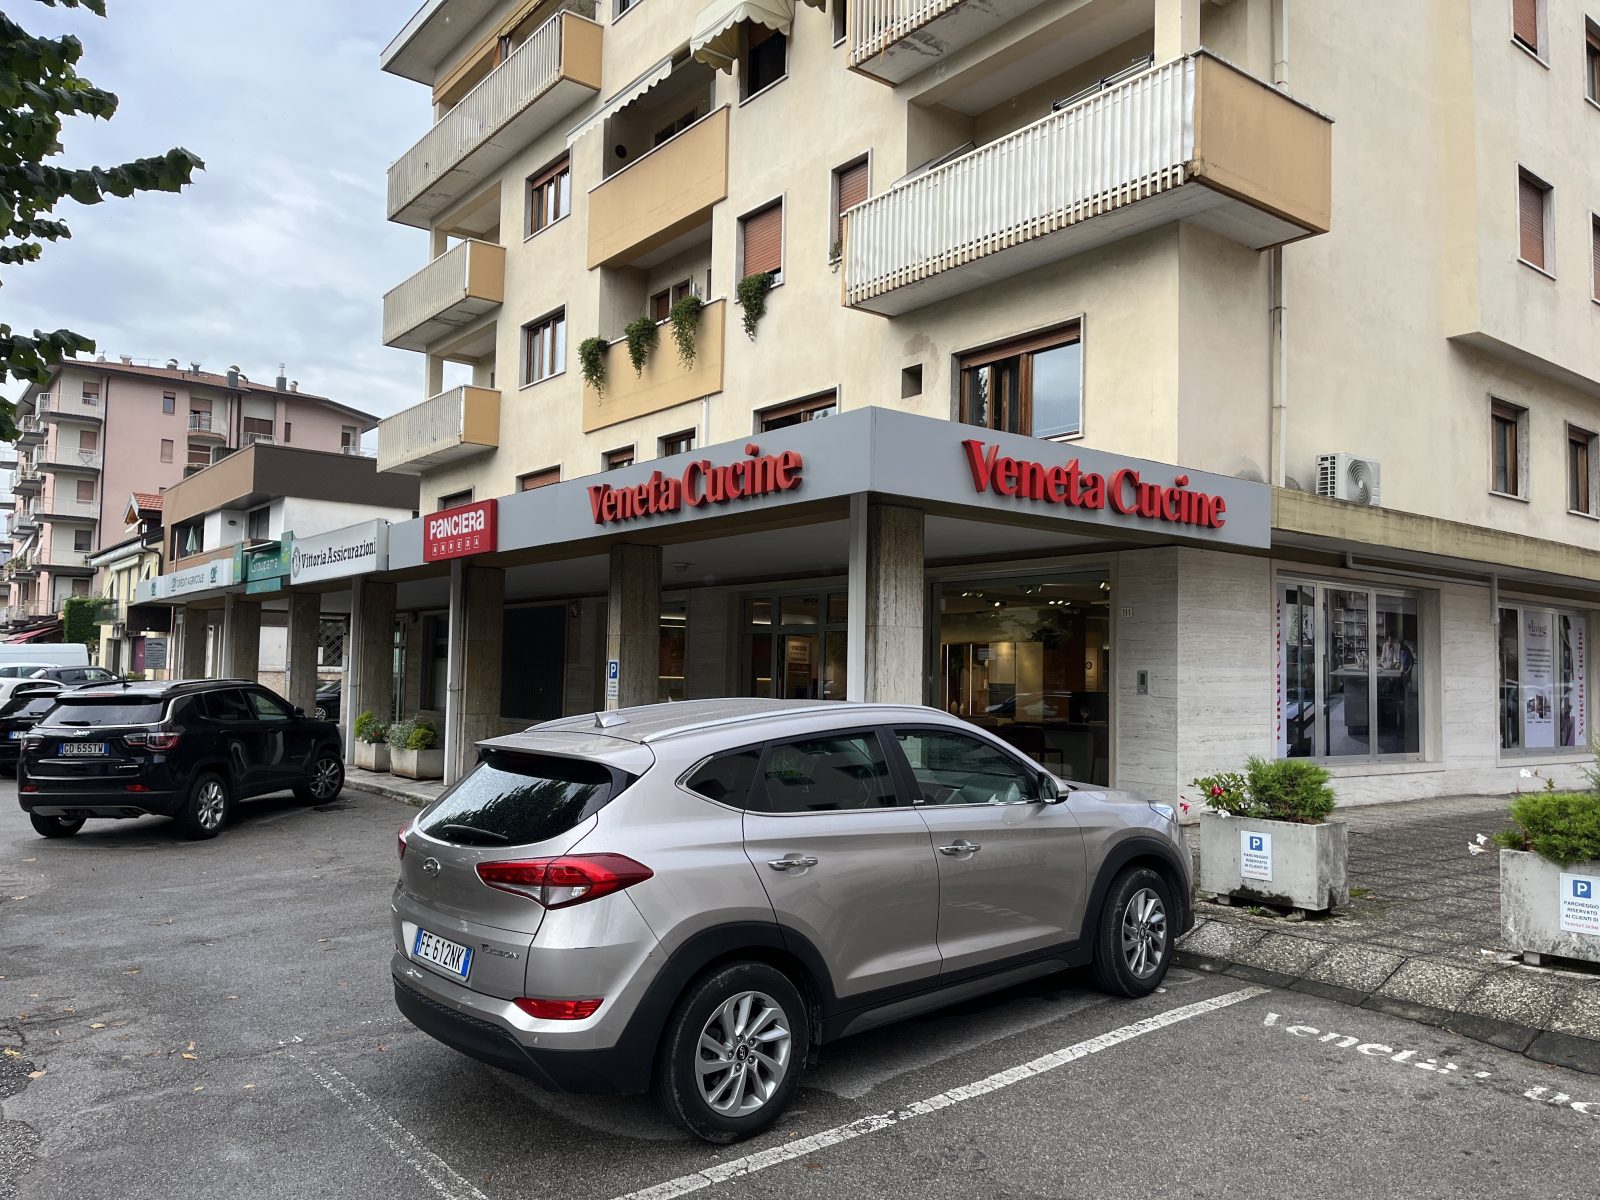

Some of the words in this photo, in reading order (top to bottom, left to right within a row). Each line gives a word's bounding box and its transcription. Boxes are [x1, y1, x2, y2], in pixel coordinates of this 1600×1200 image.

[587, 470, 682, 525] Veneta
[682, 443, 803, 508] Cucine
[961, 439, 1105, 510] Veneta
[1107, 468, 1226, 528] Cucine
[301, 551, 326, 569] Vittoria
[327, 537, 376, 564] Assicurazioni
[610, 663, 617, 677] P
[1252, 838, 1260, 849] P
[1577, 882, 1588, 896] P
[1563, 900, 1600, 910] PARCHEGGIO
[1567, 907, 1598, 916] RISERVATO
[1571, 914, 1592, 922] CLIENTI
[419, 932, 432, 956] FE
[432, 938, 465, 971] 612NK
